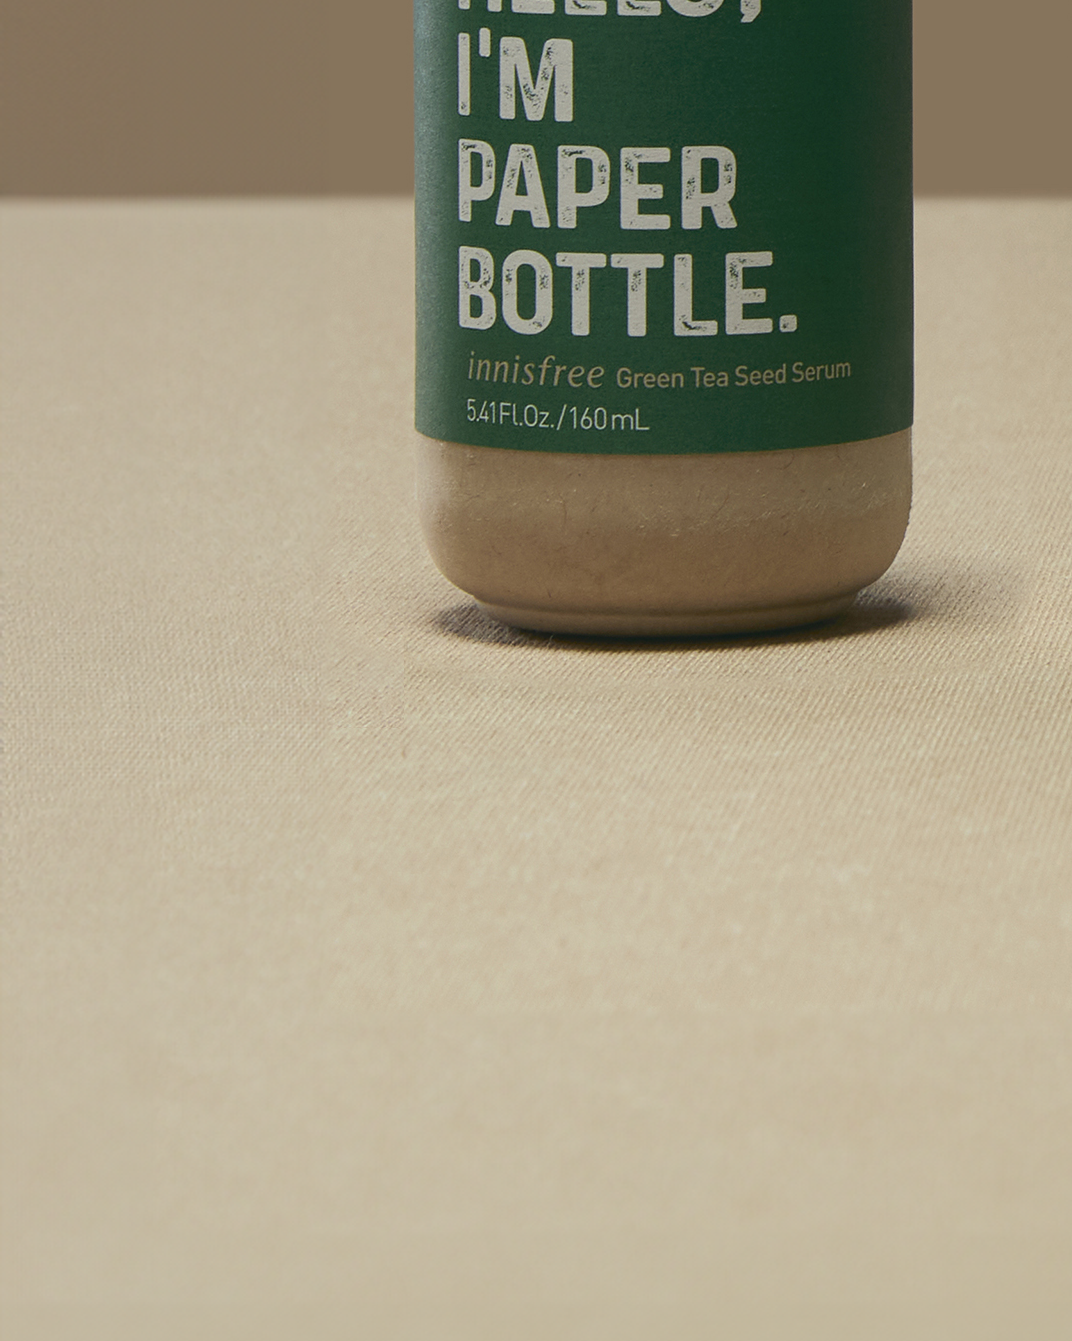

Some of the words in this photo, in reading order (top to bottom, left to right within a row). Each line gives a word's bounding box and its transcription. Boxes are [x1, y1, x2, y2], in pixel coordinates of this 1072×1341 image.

[457, 27, 574, 122] I'M
[458, 138, 738, 230] PAPER
[458, 245, 798, 337] BOTTLE.
[468, 350, 605, 389] innisfree
[616, 367, 684, 389] Green
[690, 366, 729, 388] Tea
[735, 363, 787, 386] Seed
[792, 362, 851, 383] Serum
